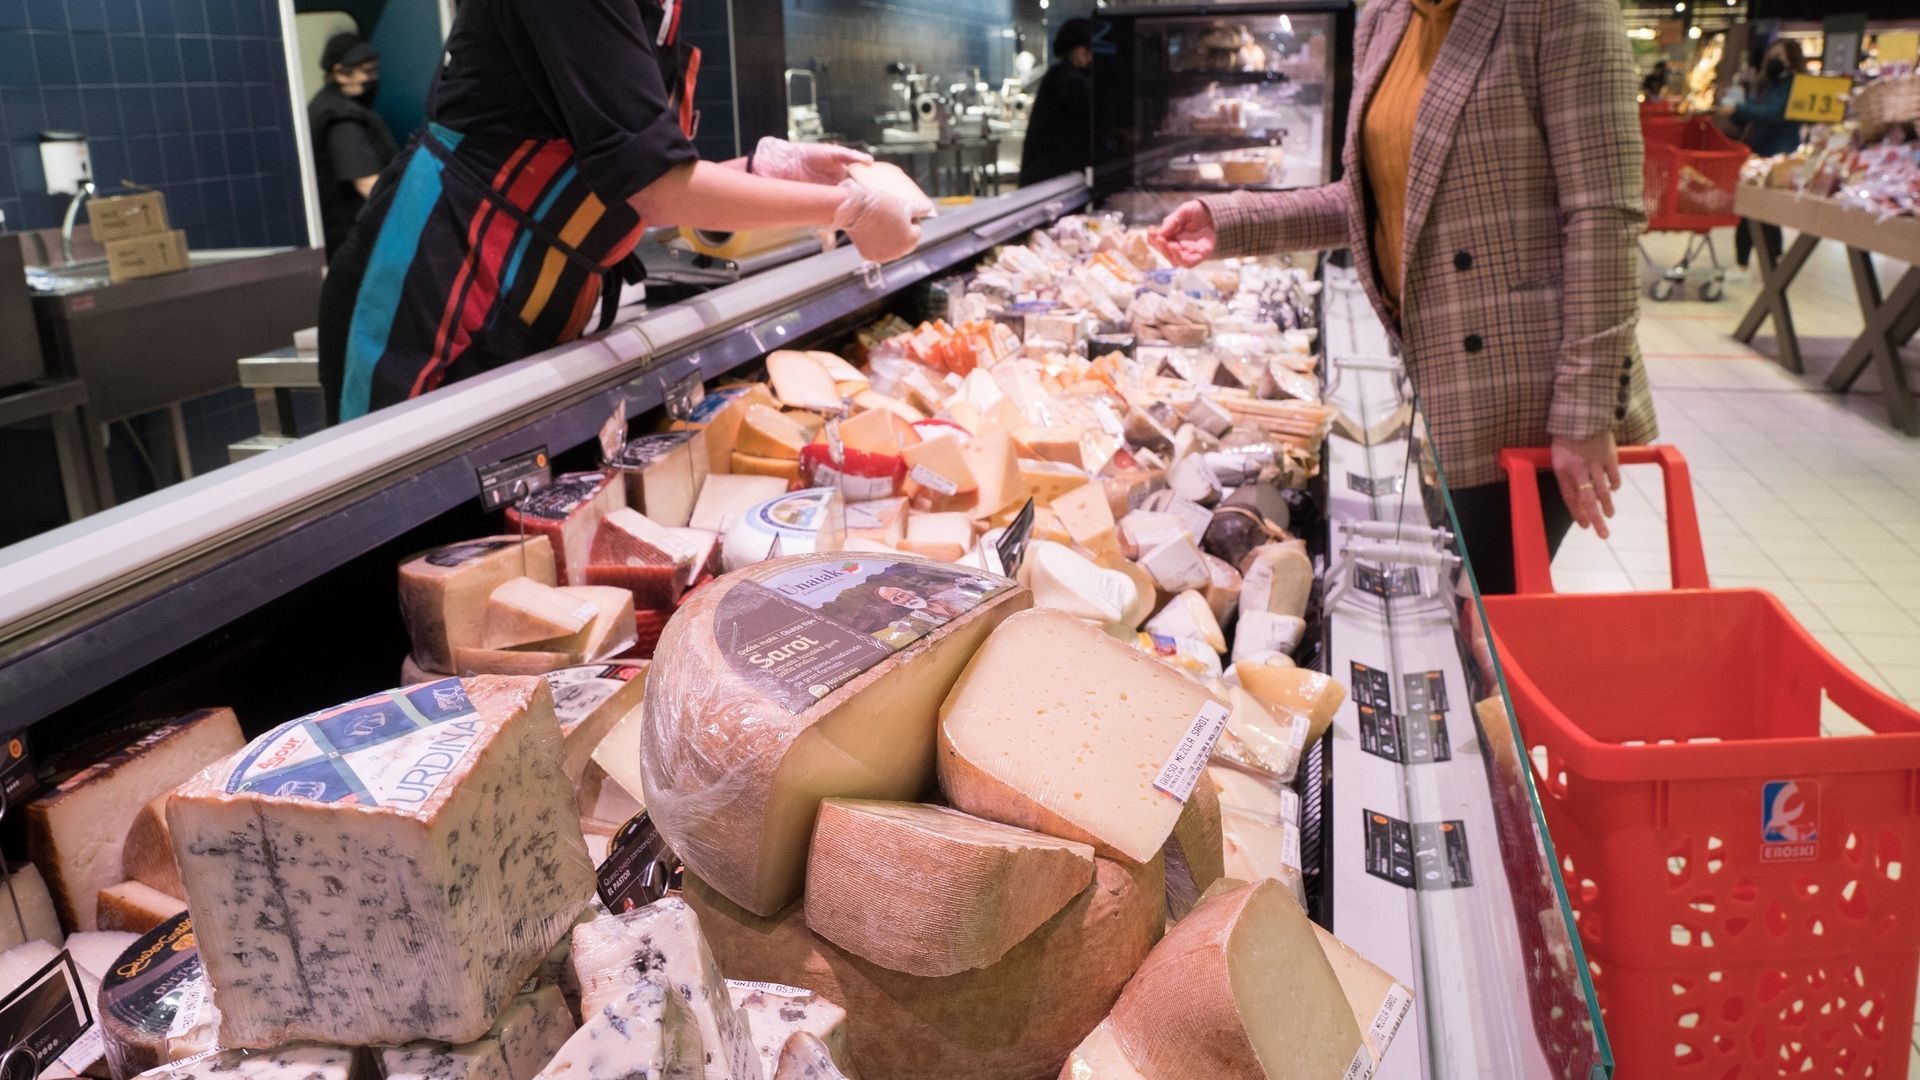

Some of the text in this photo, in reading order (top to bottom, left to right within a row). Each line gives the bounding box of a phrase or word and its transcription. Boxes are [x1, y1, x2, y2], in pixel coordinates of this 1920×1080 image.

[777, 569, 844, 595] Unaiak
[780, 624, 803, 636] Queso
[749, 634, 820, 669] Saroi
[785, 644, 863, 684] Nuestro queso madurado
[794, 660, 845, 688] de gran formato
[257, 735, 301, 771] Agour
[386, 719, 480, 805] URDINA
[1160, 715, 1210, 786] QUESO MEZCLA SAROI
[1764, 844, 1815, 859] EROSKI
[603, 867, 621, 887] Queso
[606, 869, 632, 897] EL PASTOR
